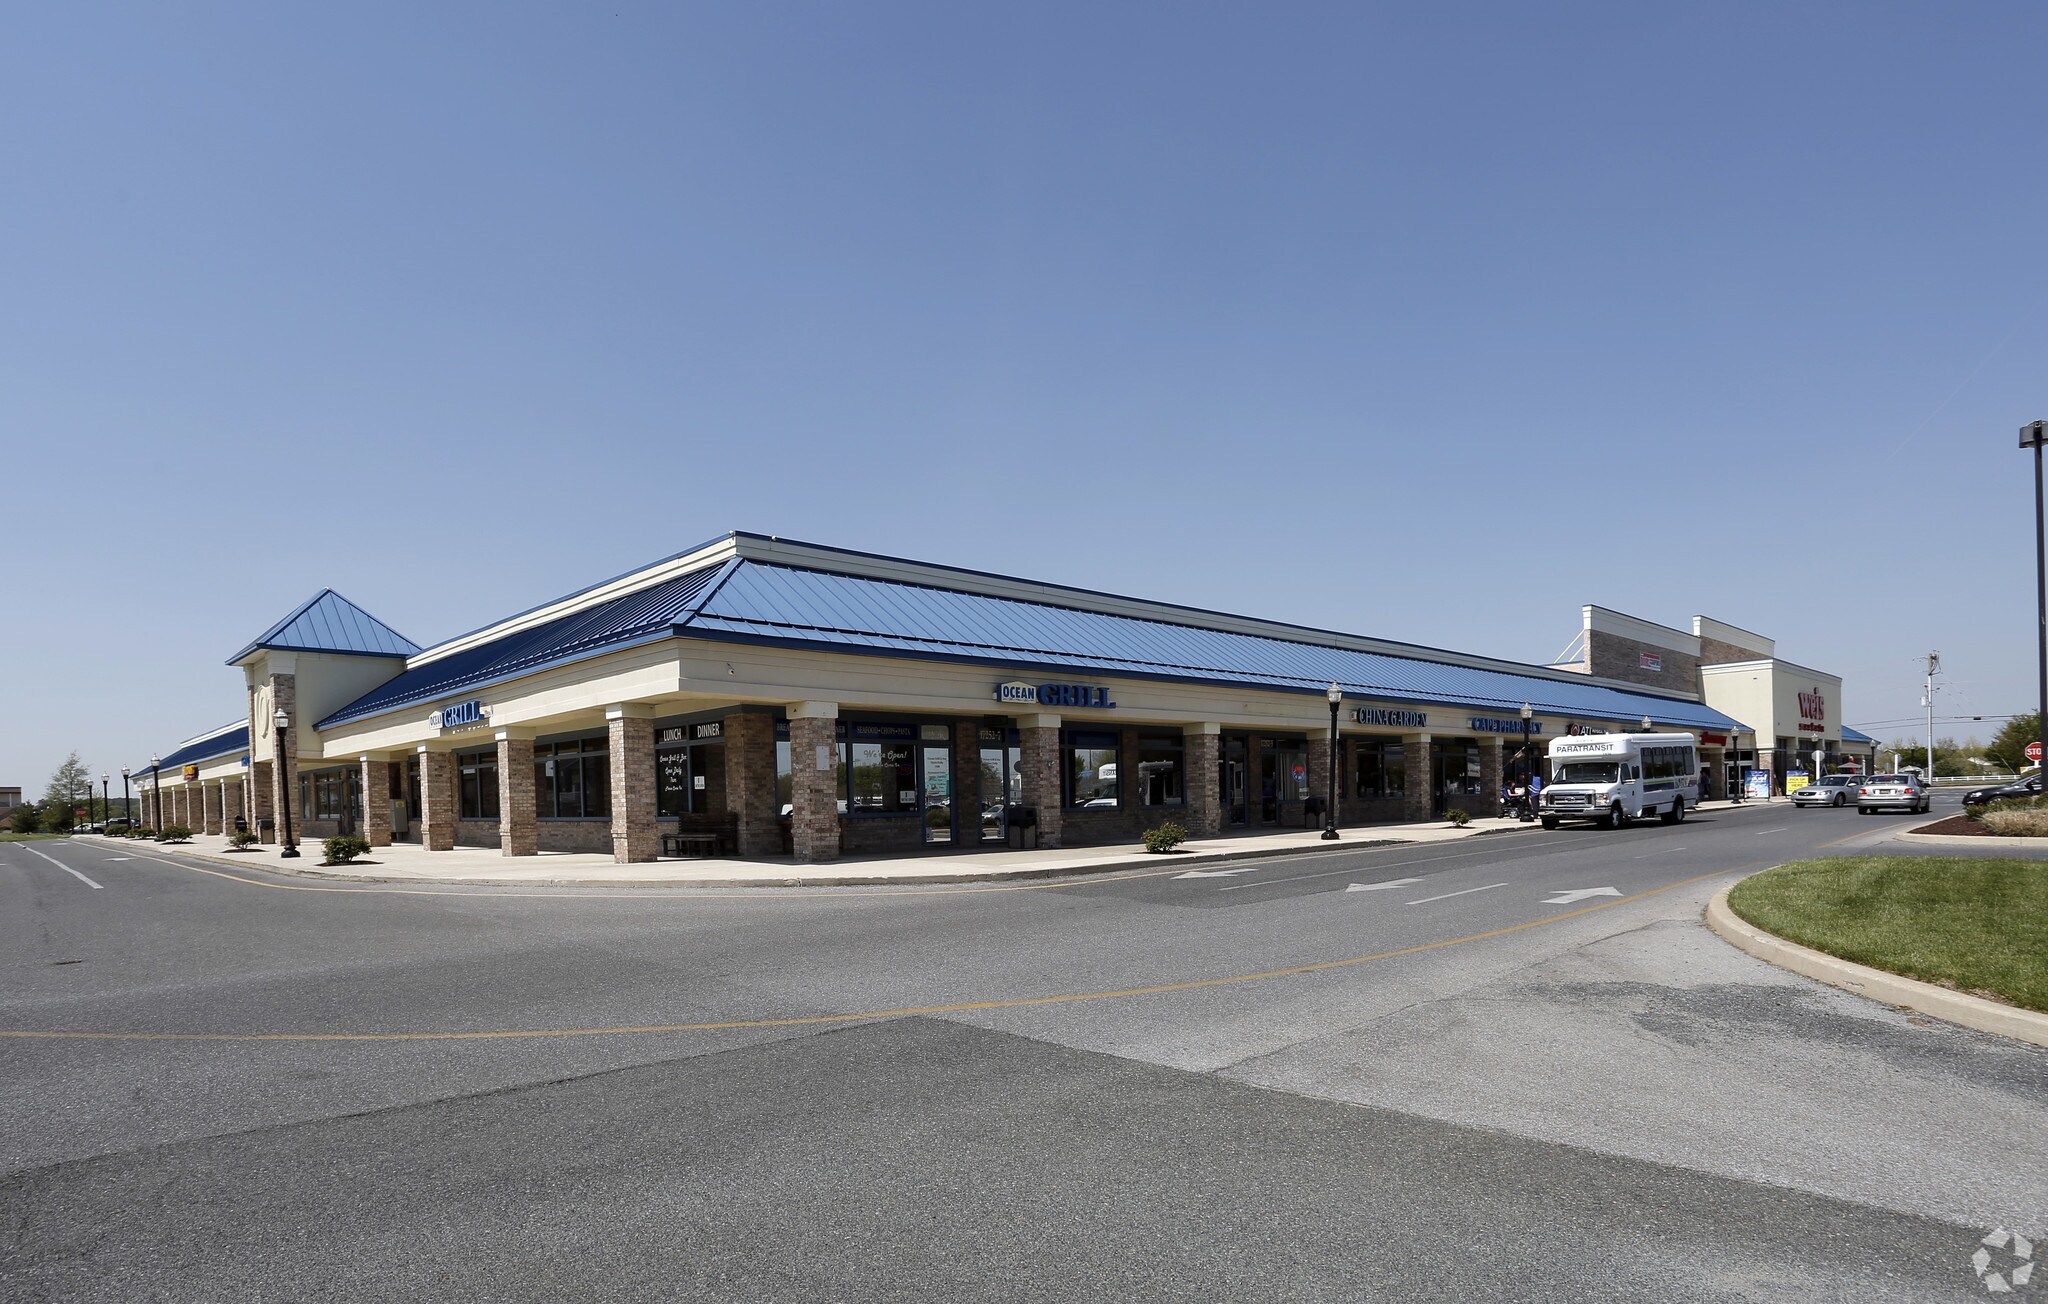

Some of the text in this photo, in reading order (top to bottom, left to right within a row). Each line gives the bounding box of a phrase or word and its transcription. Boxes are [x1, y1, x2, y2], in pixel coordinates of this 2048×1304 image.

[1003, 683, 1117, 709] OCEAN GRILL
[444, 701, 482, 727] GRILL
[1360, 707, 1427, 727] CHINA GARDEN
[664, 728, 682, 741] LUNCH
[697, 723, 720, 738] DINNER
[1581, 726, 1592, 735] ATI
[1557, 743, 1614, 753] PARATRANSIT
[2026, 748, 2042, 756] STO
[888, 750, 908, 761] Open!
